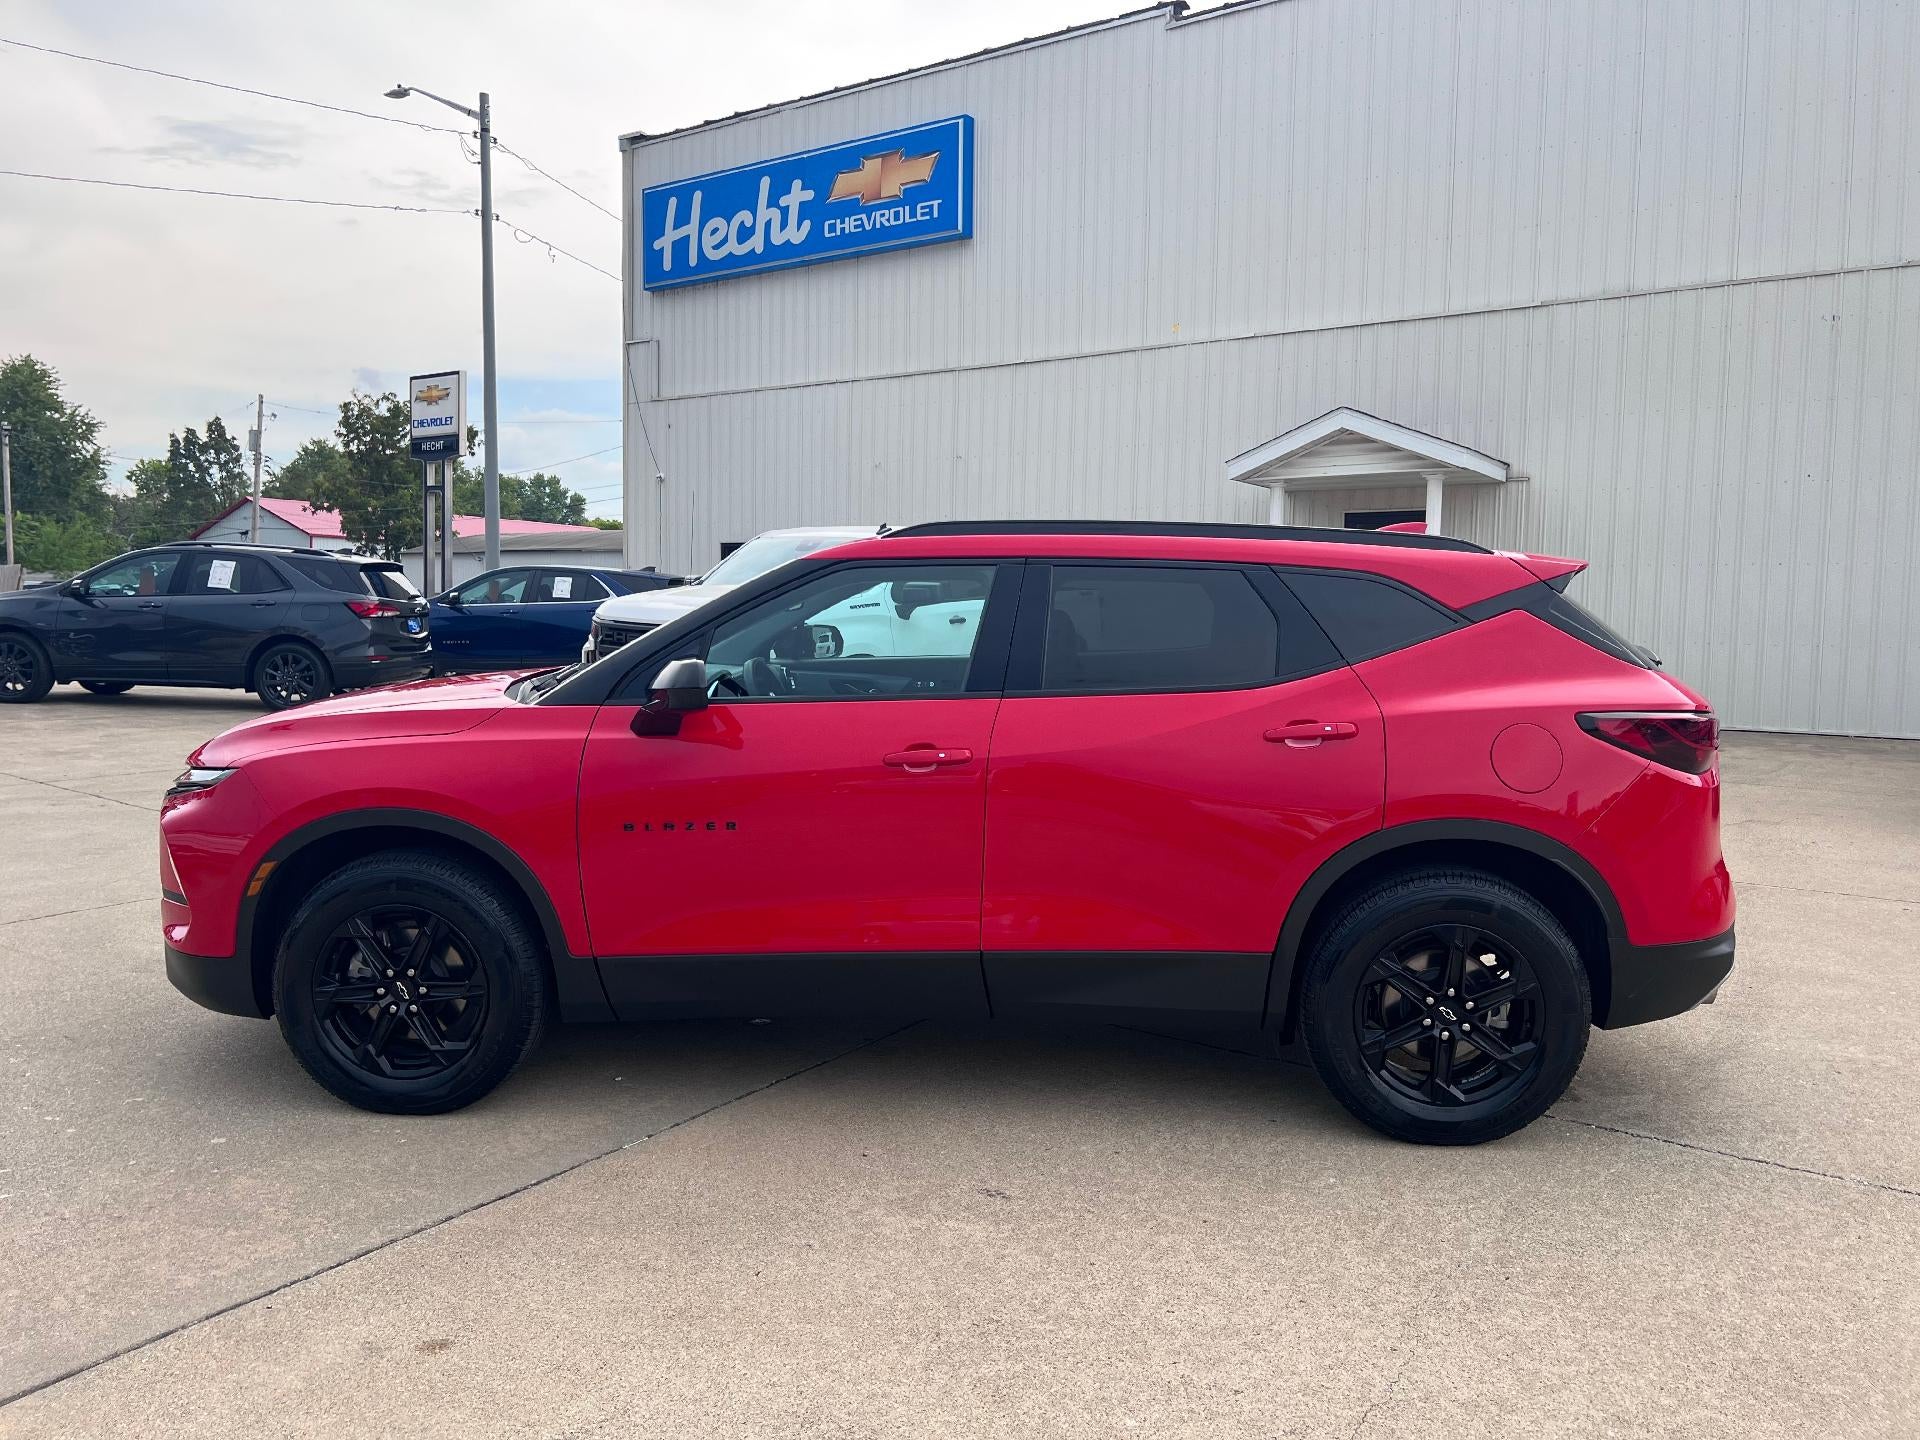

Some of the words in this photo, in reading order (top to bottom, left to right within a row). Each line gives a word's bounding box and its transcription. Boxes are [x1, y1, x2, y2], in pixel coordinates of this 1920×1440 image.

[653, 175, 815, 272] Hecht
[823, 199, 943, 238] CHEVROLET
[412, 416, 454, 429] CHEVROLET
[421, 440, 444, 451] HECHT
[622, 821, 738, 832] BLAZER
